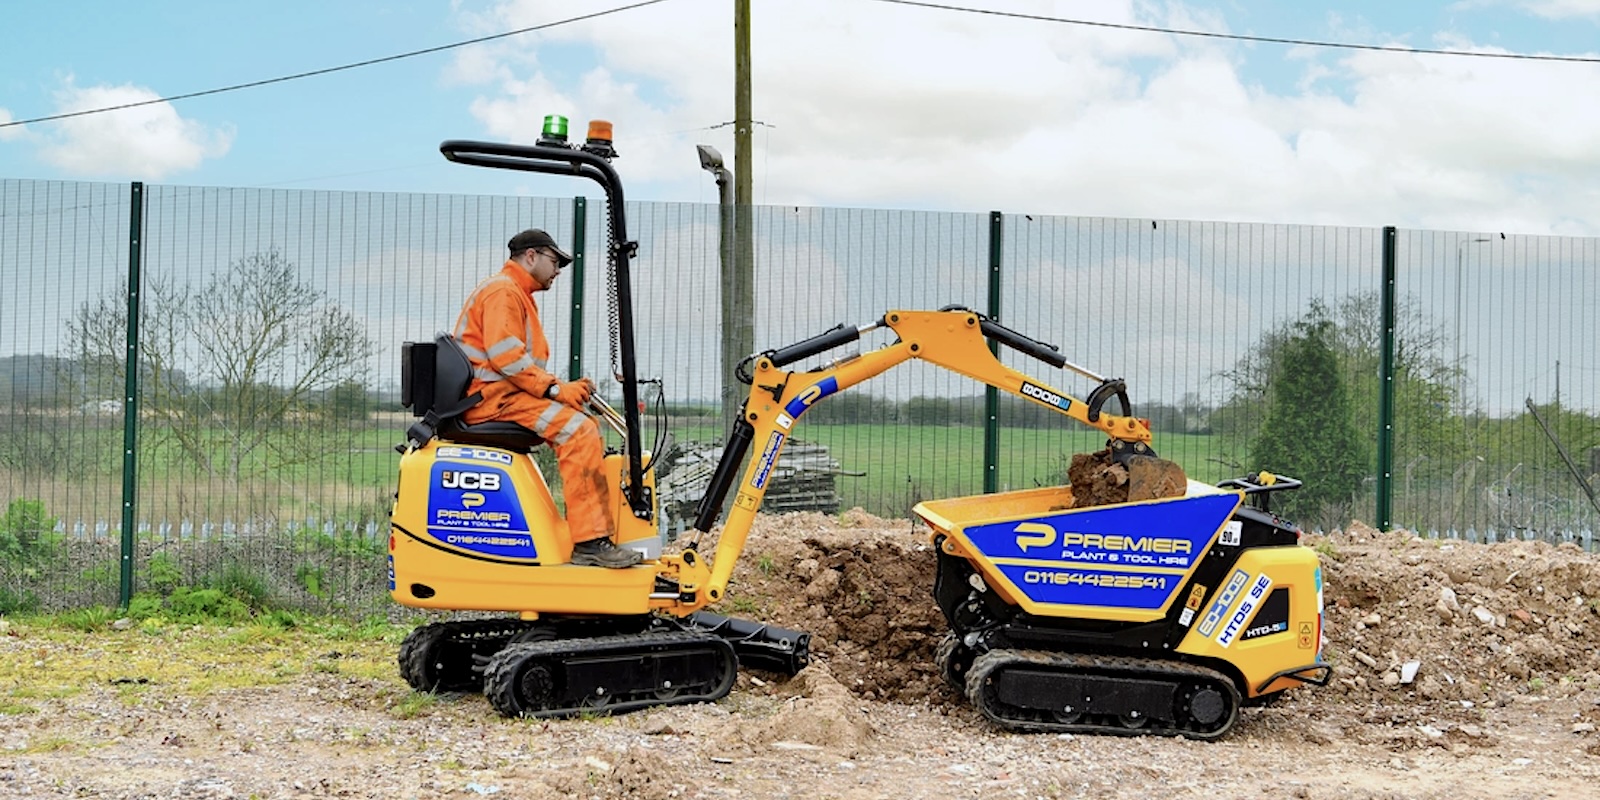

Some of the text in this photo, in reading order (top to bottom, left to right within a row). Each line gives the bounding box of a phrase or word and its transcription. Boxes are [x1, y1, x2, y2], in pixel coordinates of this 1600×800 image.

[442, 471, 500, 491] JCB
[437, 509, 511, 522] PREMIER
[447, 535, 530, 547] 01164422541
[1063, 532, 1193, 554] PREMIER
[1061, 550, 1107, 561] PLANT
[1123, 554, 1156, 565] TOOL
[1158, 556, 1189, 566] HIRE
[1024, 571, 1167, 589] 01164422541
[1219, 576, 1270, 644] HTD5 SE
